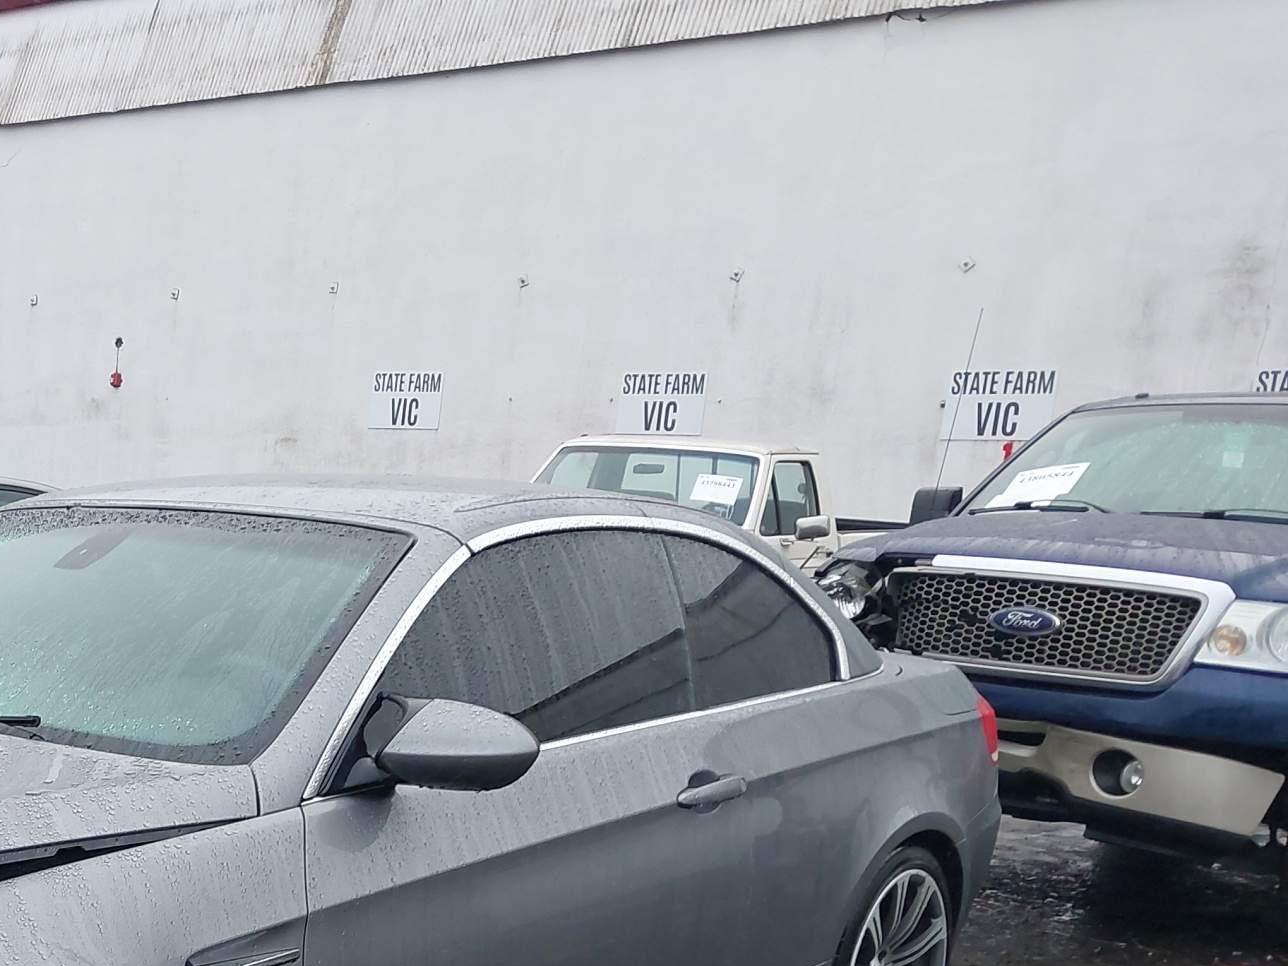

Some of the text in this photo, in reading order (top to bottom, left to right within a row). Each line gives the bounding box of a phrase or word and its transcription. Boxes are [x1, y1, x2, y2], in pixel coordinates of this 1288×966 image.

[374, 373, 442, 392] STATE FARM
[623, 373, 706, 395] STATE FARM
[951, 370, 1056, 395] STATE FARM
[391, 397, 419, 427] VIC
[644, 400, 677, 432] VIC
[977, 402, 1020, 437] VIC
[1002, 611, 1043, 629] Ford
